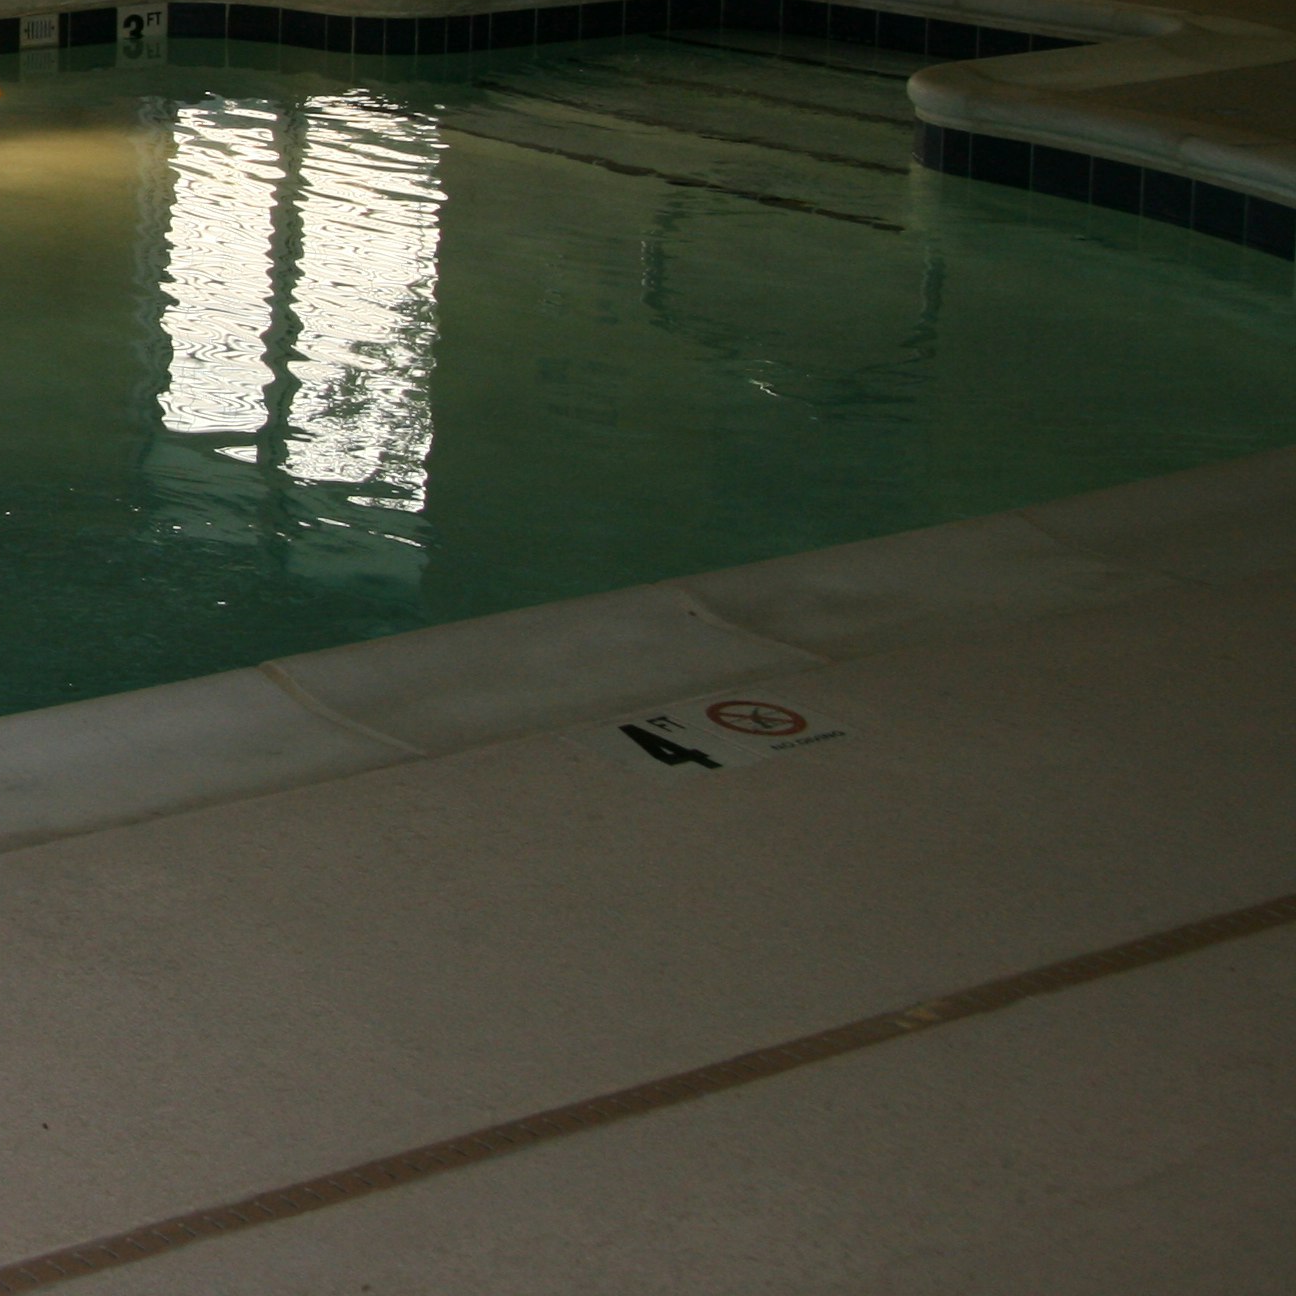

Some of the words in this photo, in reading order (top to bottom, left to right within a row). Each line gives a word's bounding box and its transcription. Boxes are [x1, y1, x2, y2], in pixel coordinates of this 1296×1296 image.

[146, 11, 163, 27] FT
[646, 716, 687, 734] FT
[618, 724, 724, 770] 4
[770, 741, 795, 751] NO
